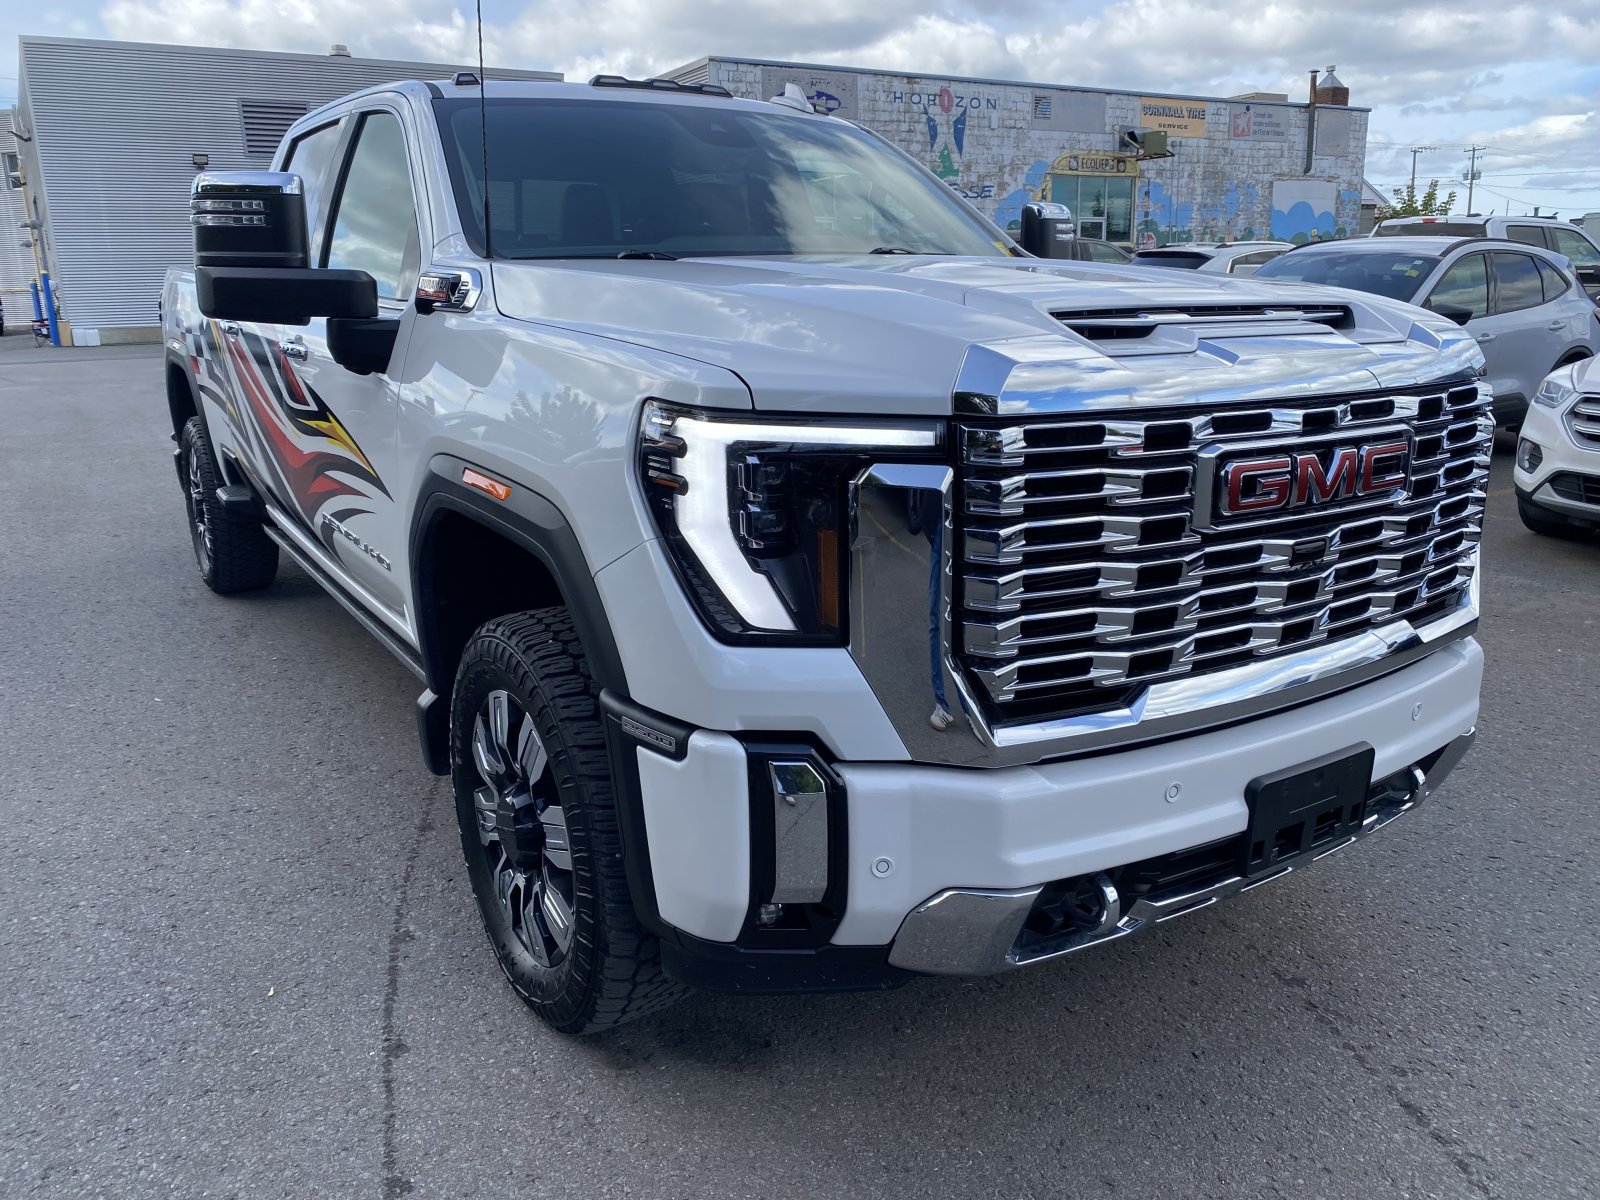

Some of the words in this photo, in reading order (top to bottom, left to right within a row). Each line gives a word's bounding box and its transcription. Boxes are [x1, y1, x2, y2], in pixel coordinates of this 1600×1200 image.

[892, 91, 997, 110] HORIZON
[1142, 103, 1185, 119] CORNWALL
[1186, 106, 1206, 120] TIRE
[1157, 122, 1189, 130] SERVICE
[1220, 441, 1409, 516] GMC
